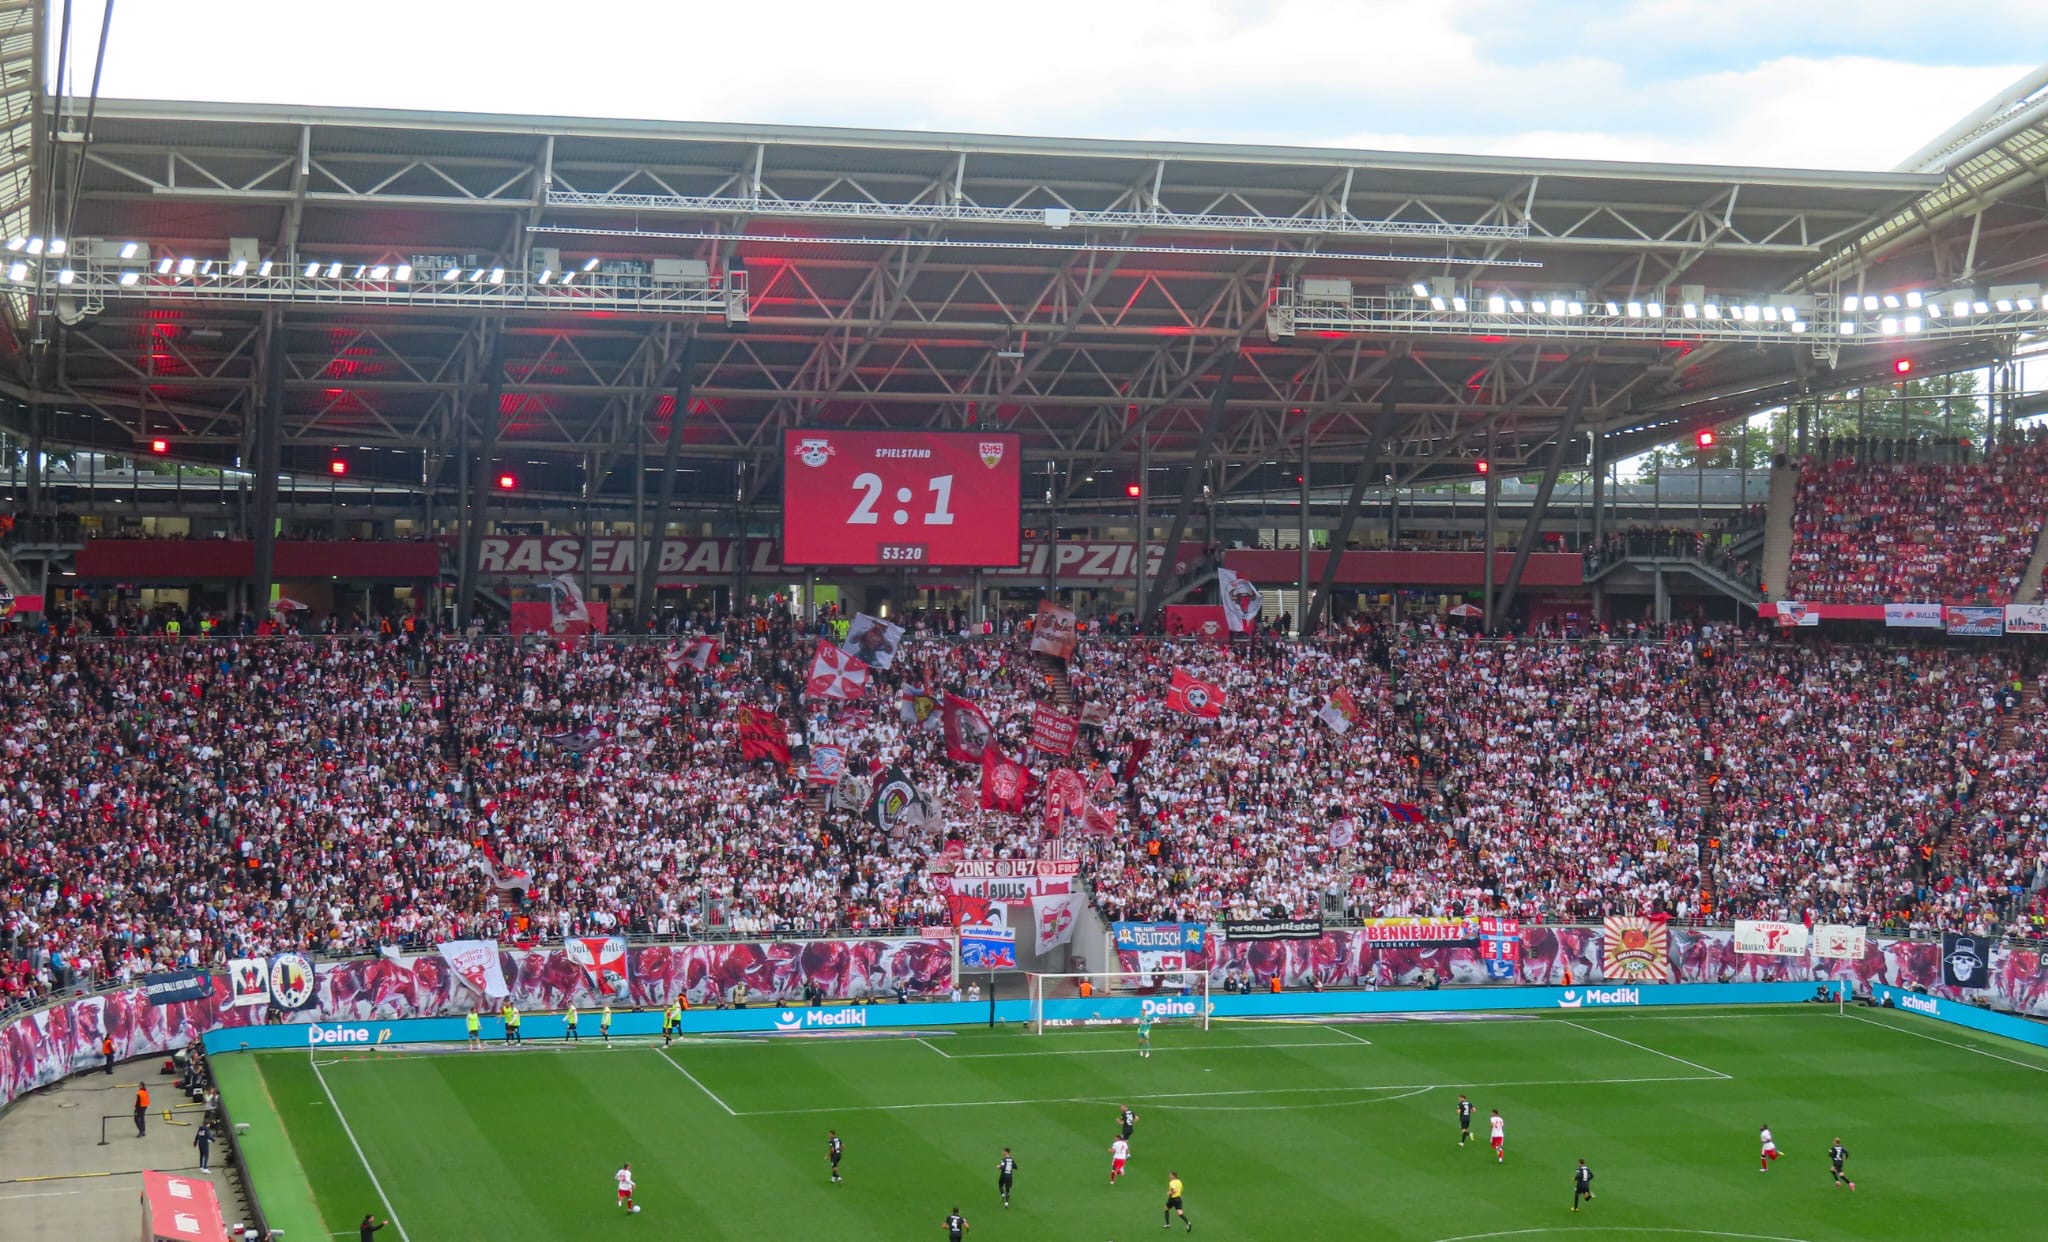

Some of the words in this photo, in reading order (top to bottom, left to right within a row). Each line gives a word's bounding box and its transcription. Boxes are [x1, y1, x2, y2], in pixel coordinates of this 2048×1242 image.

[875, 448, 931, 459] SPIELSTAND
[882, 547, 922, 560] 53:20
[954, 861, 994, 877] ZONE
[1012, 860, 1036, 876] 147
[990, 883, 1026, 899] BULLS
[1368, 925, 1461, 941] BENNEWITZ
[1482, 920, 1517, 933] BLOCK
[1135, 932, 1180, 946] DELITZSCH
[1142, 999, 1195, 1015] Deine
[1902, 995, 1940, 1015] schnell.
[308, 1024, 369, 1044] Deine
